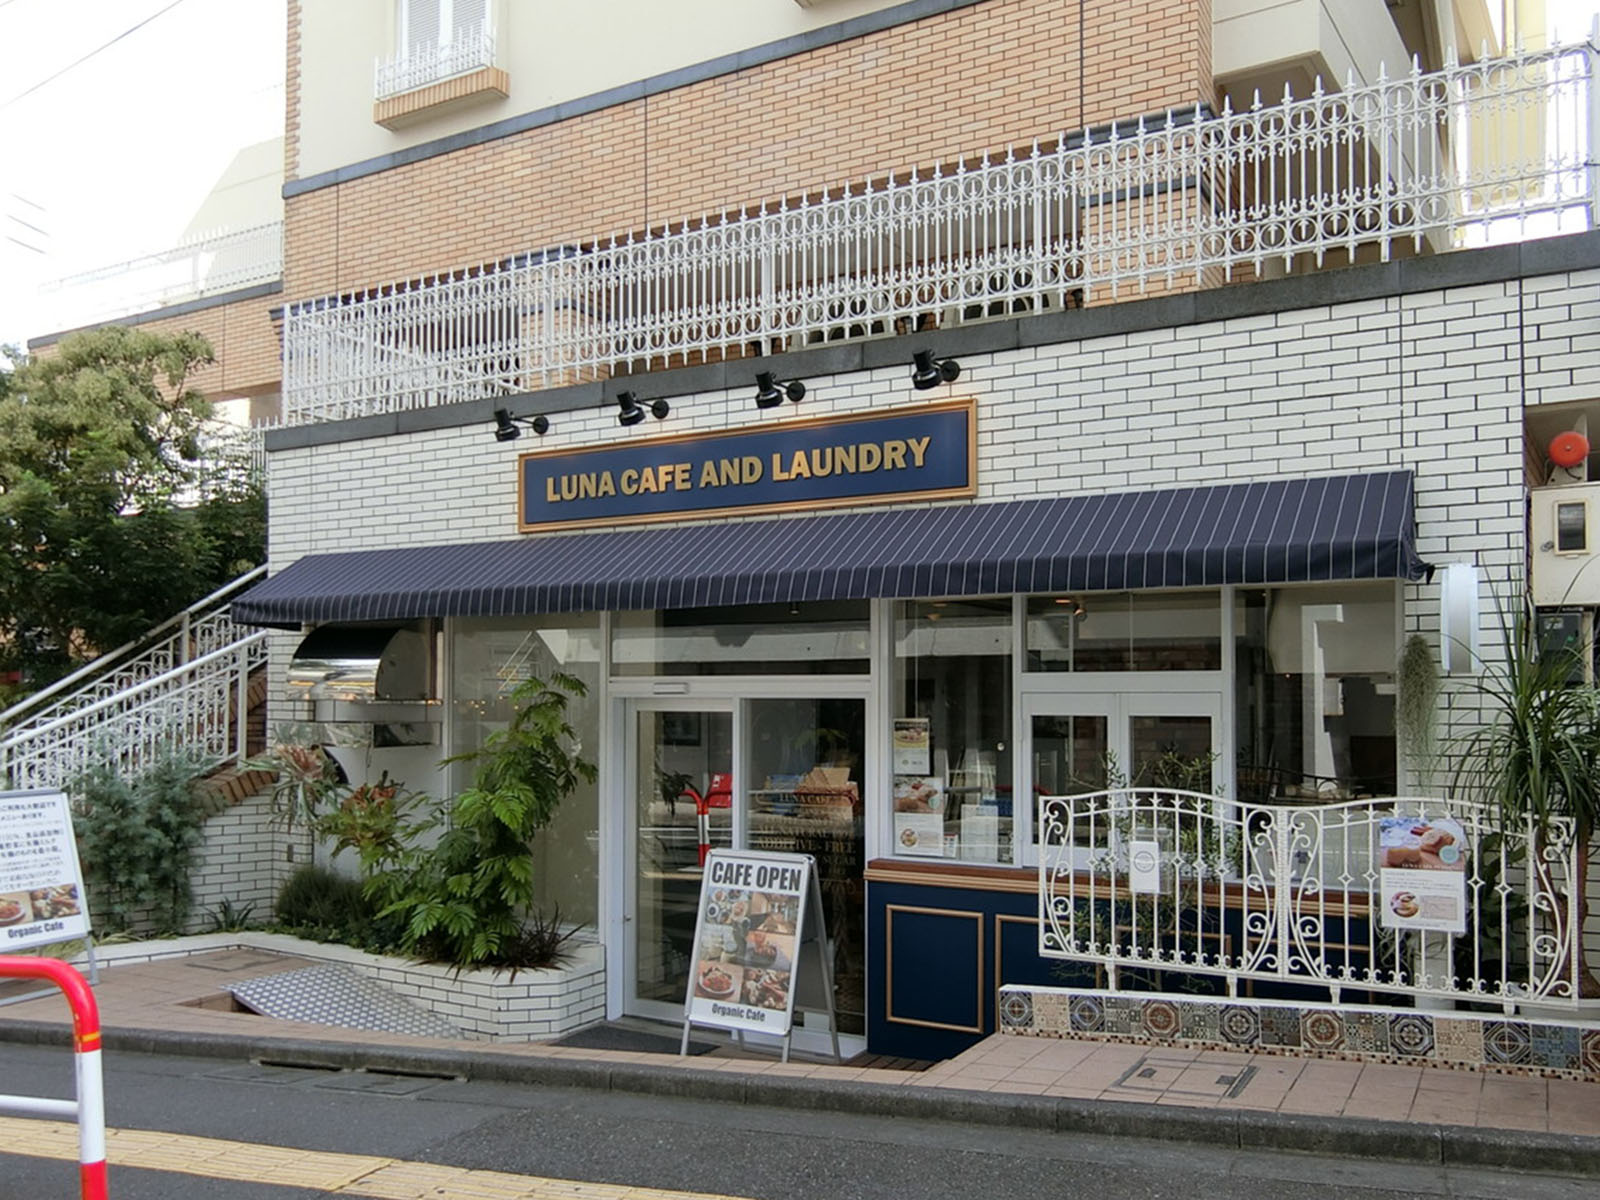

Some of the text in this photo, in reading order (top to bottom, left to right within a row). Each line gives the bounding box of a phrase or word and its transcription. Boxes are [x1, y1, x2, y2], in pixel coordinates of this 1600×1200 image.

[546, 436, 931, 502] LUNA CAFE AND LAUNDRY
[711, 861, 753, 886] CAFE
[756, 865, 802, 892] OPEN
[8, 921, 64, 939] Organic Cafe
[711, 1003, 766, 1022] Organic Cafe
